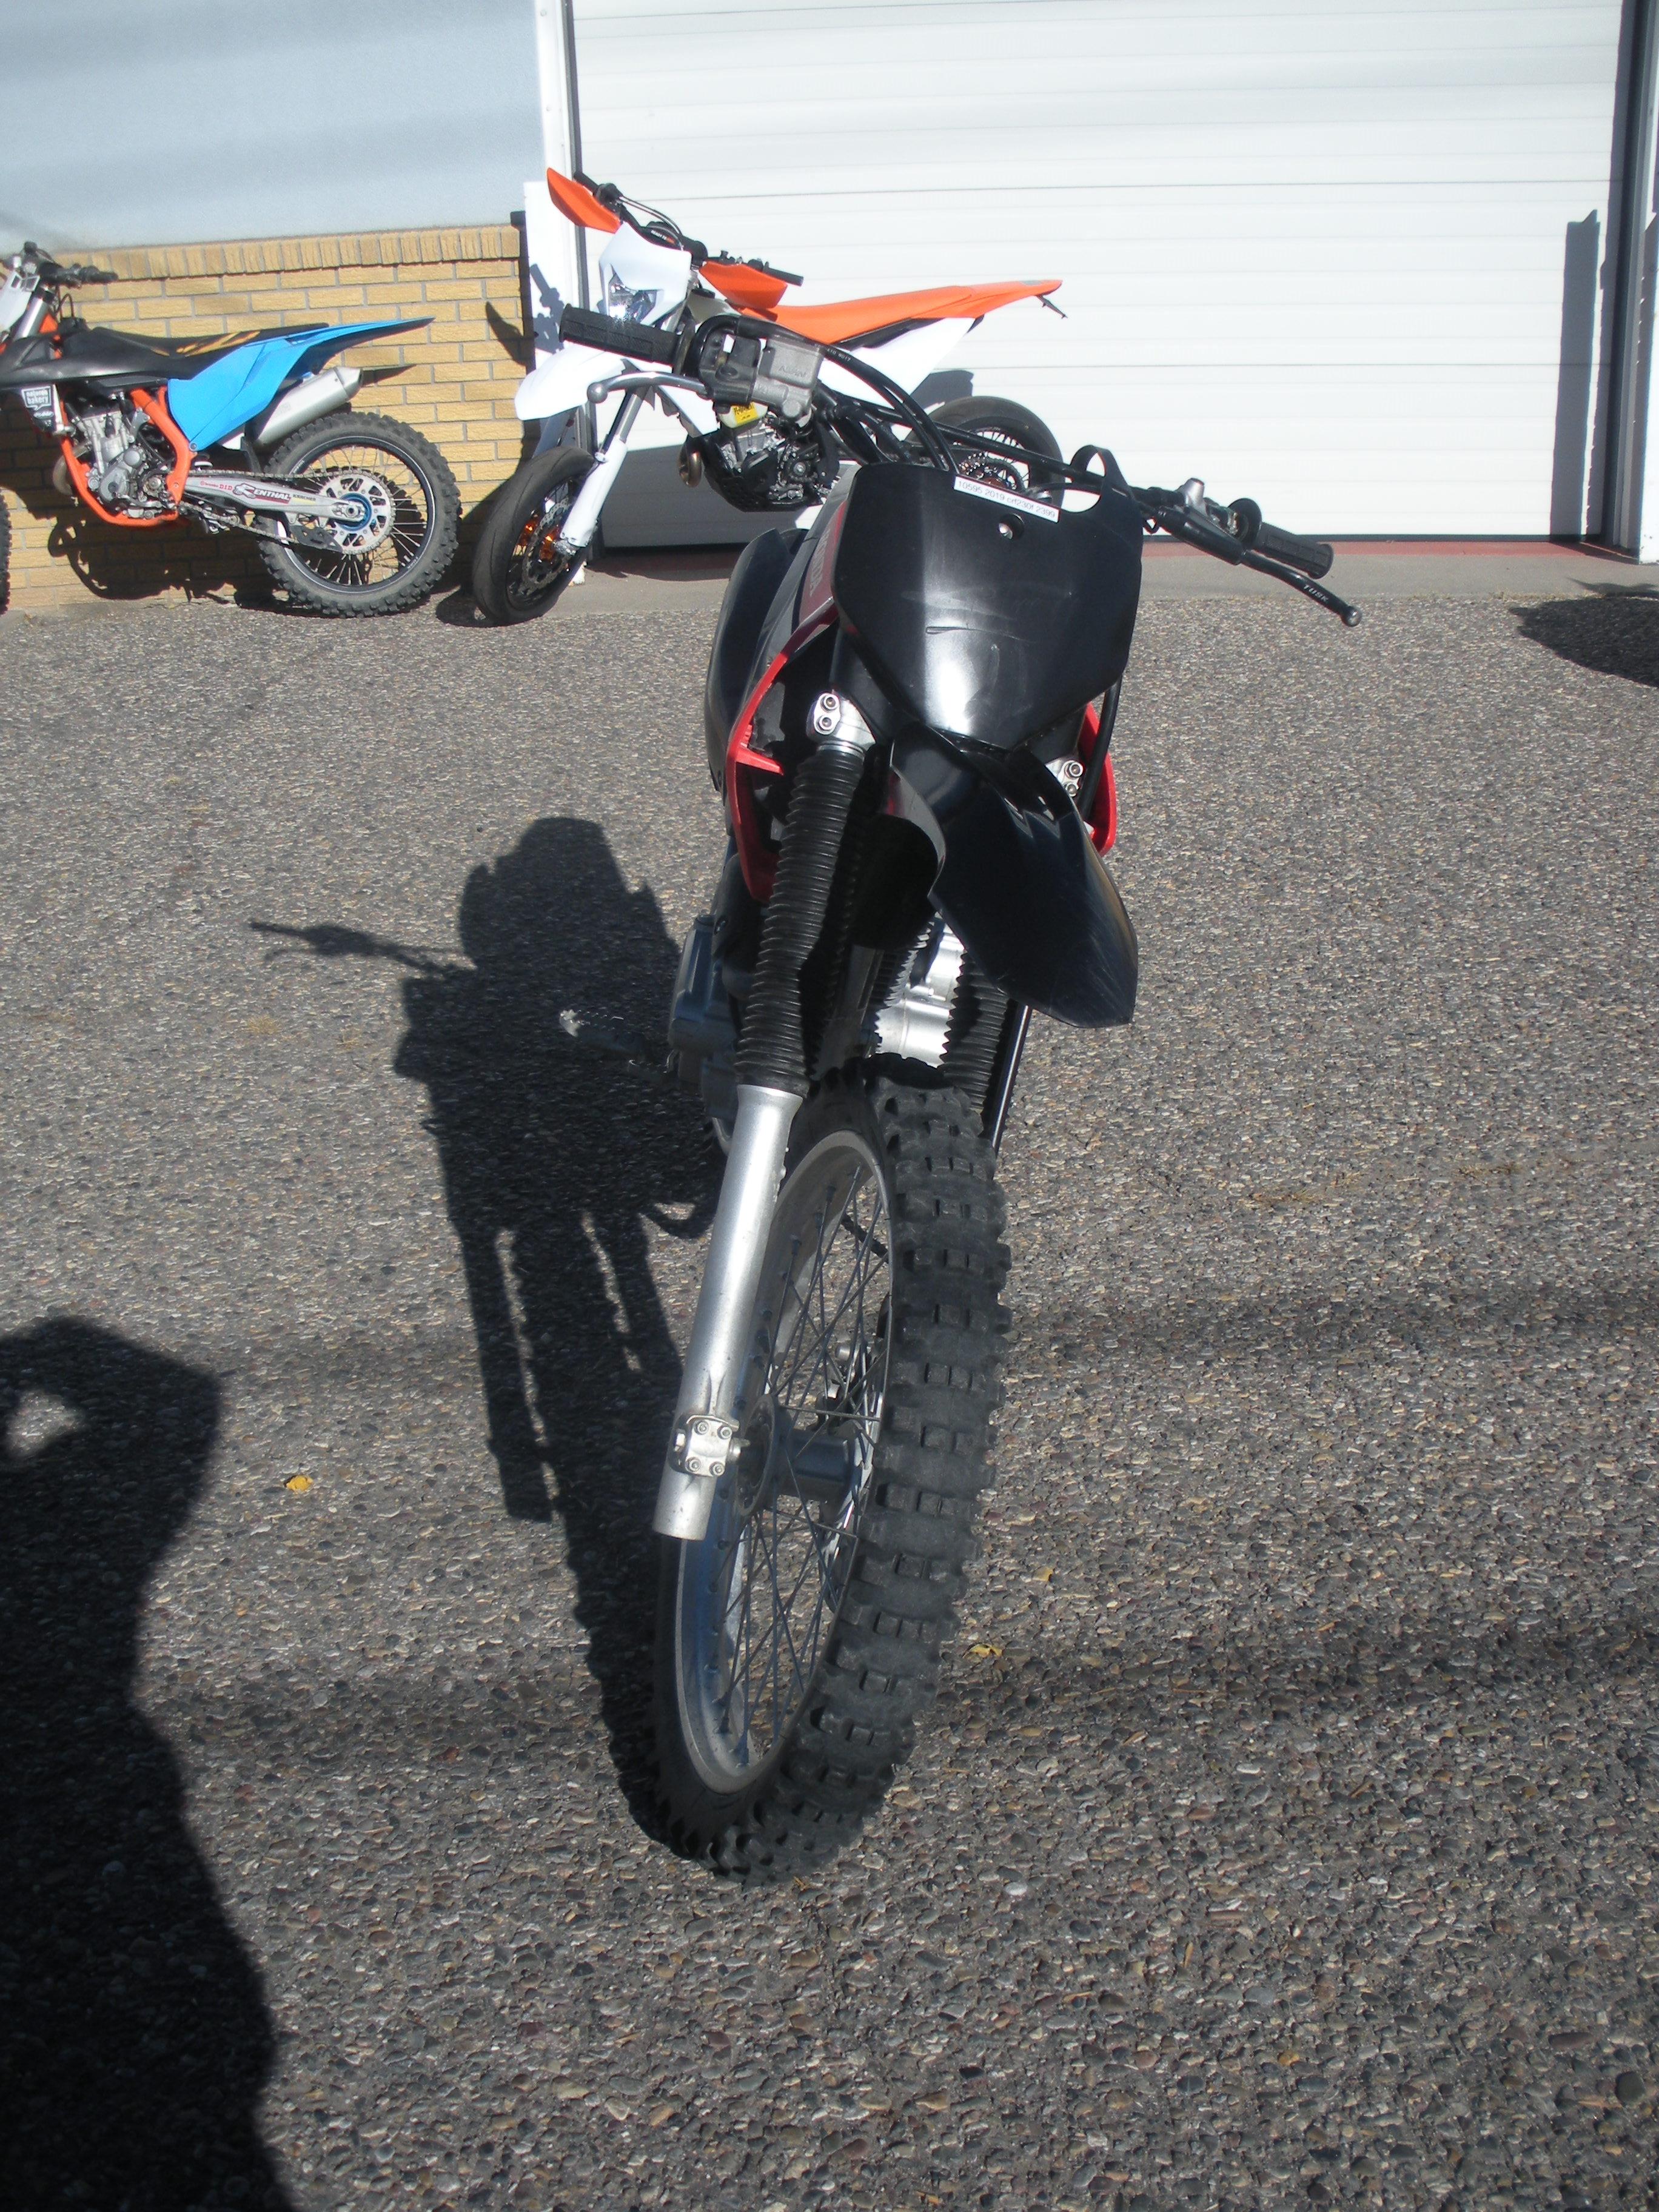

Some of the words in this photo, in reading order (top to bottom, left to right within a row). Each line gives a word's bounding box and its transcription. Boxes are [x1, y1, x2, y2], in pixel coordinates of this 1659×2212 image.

[27, 396, 49, 404] bakery
[959, 480, 982, 494] 10595
[985, 489, 1005, 501] 2019
[1036, 506, 1056, 518] 2399
[1304, 585, 1329, 602] TUSK
